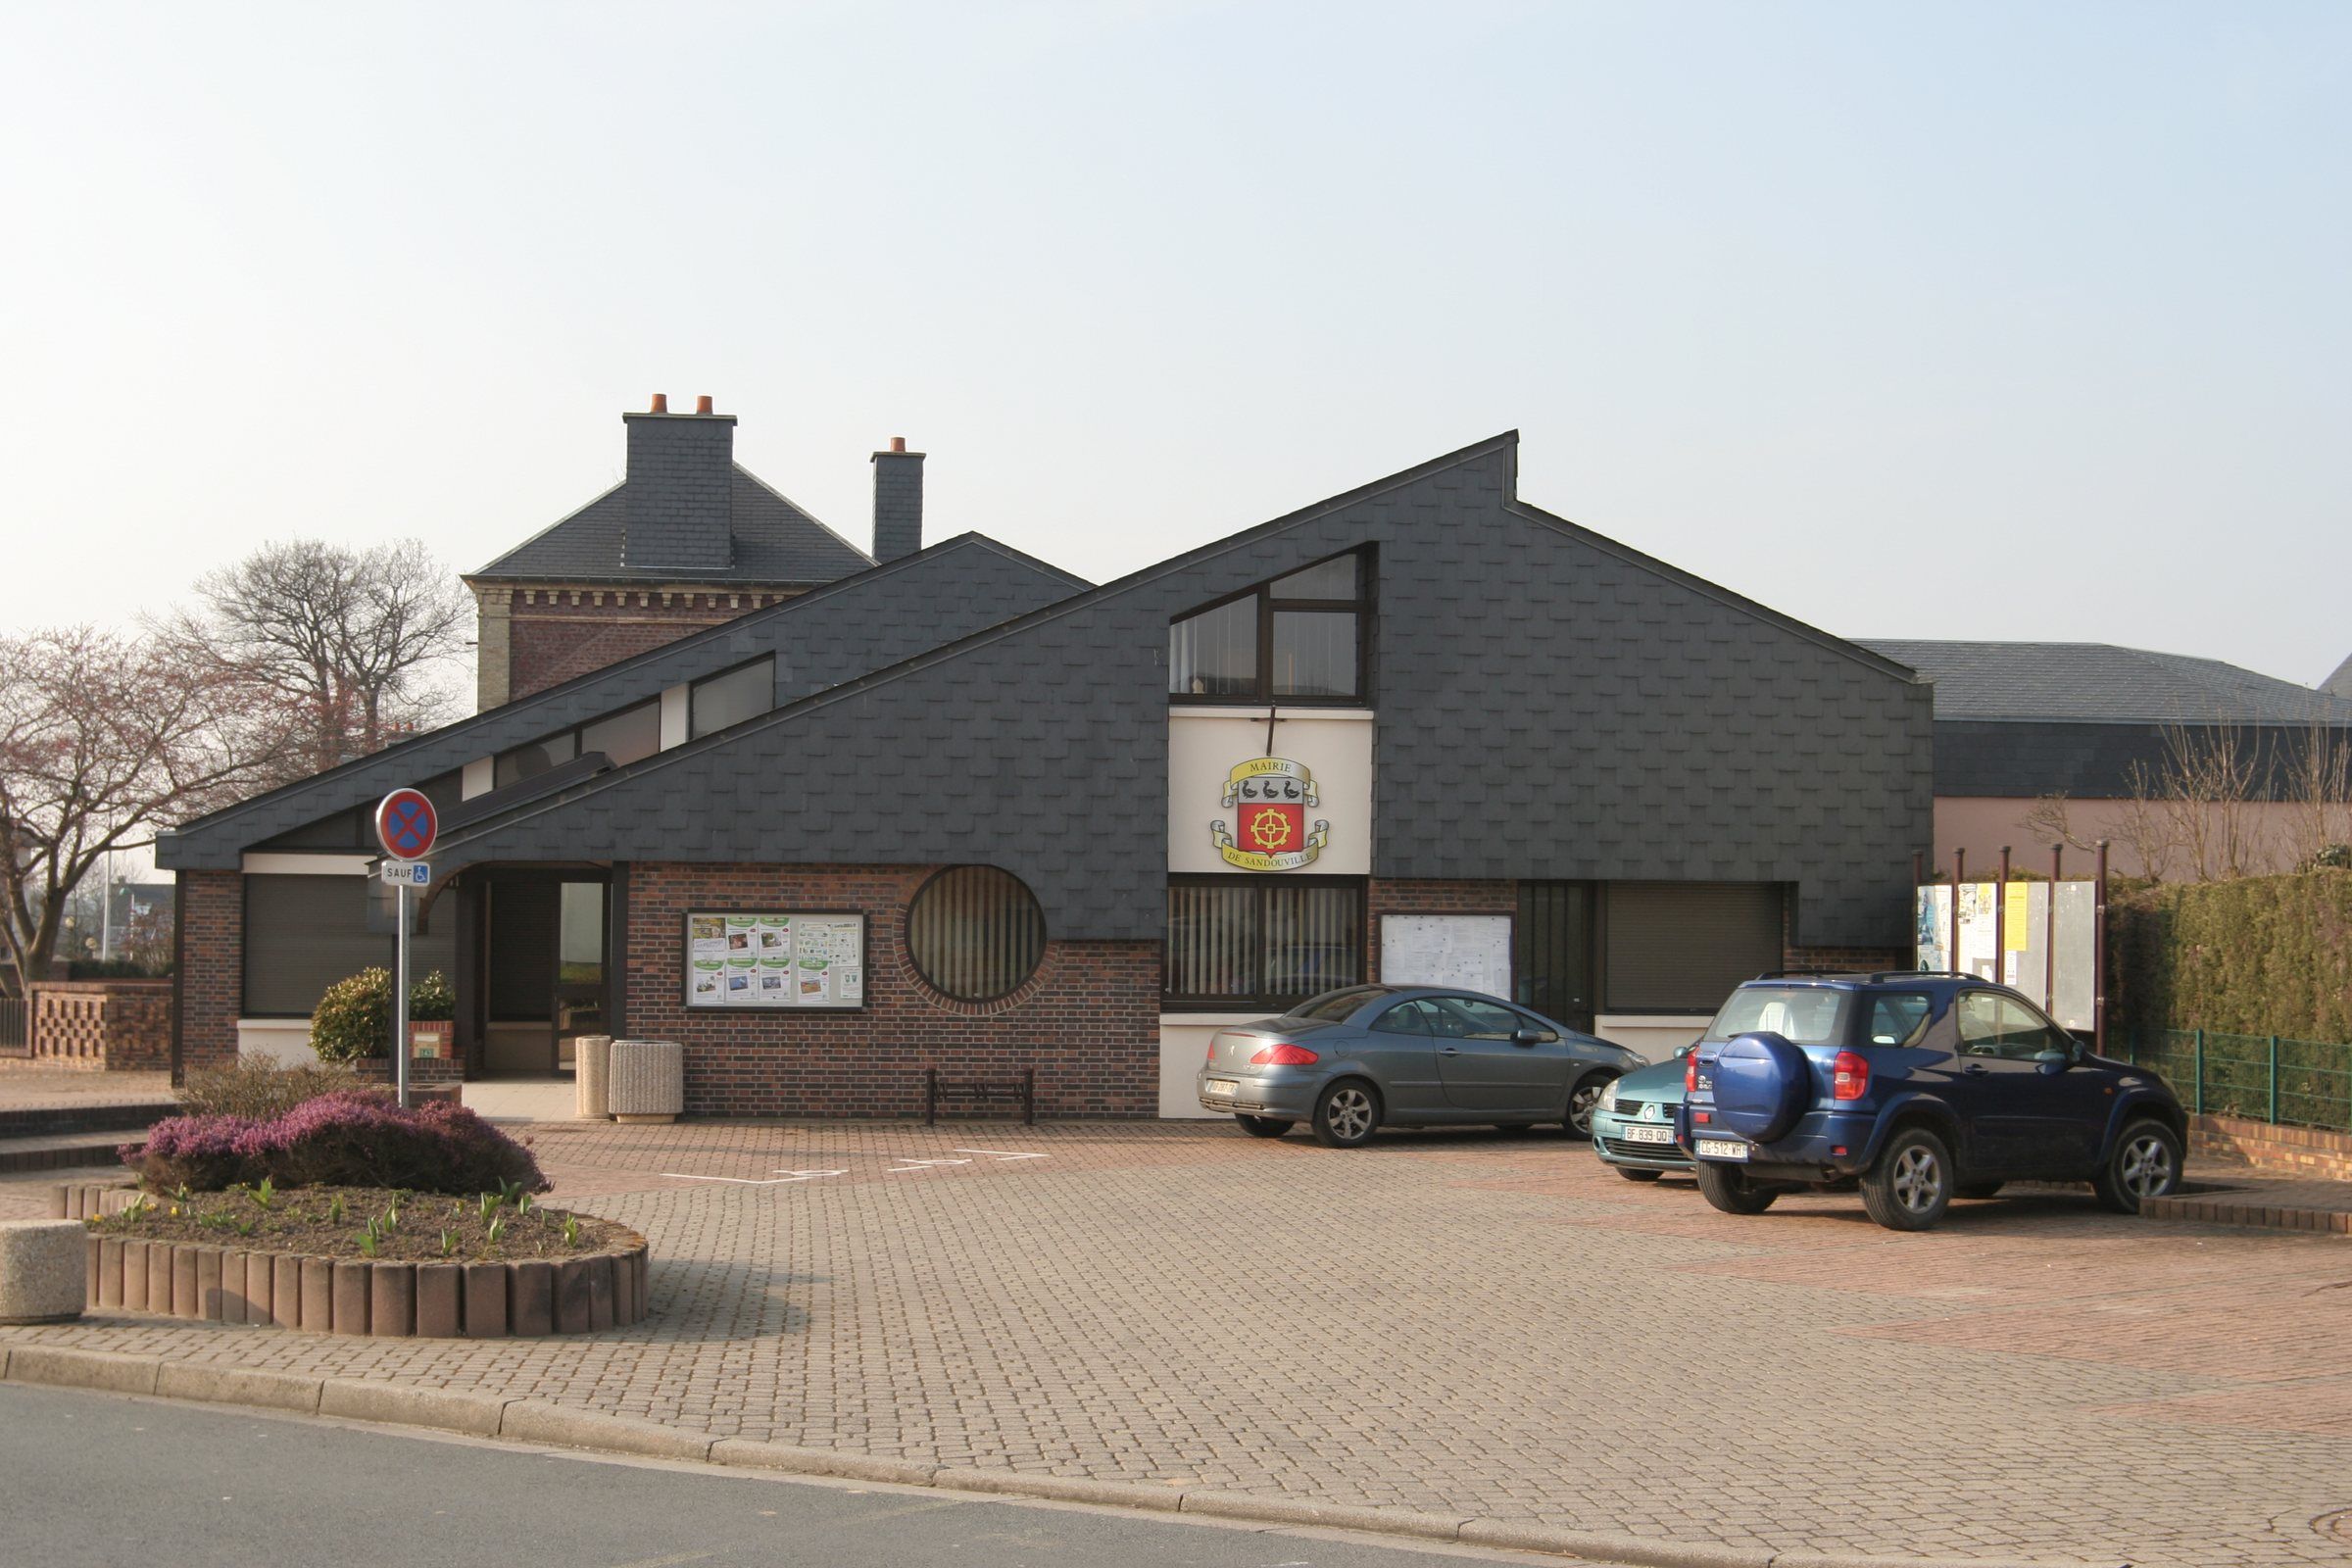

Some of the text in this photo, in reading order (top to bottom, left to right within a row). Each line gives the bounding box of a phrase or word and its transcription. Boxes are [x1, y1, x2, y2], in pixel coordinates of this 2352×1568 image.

[1250, 761, 1292, 772] MAIRIE
[1228, 851, 1313, 867] DE SANDOUVILLE
[387, 867, 412, 878] SAUF
